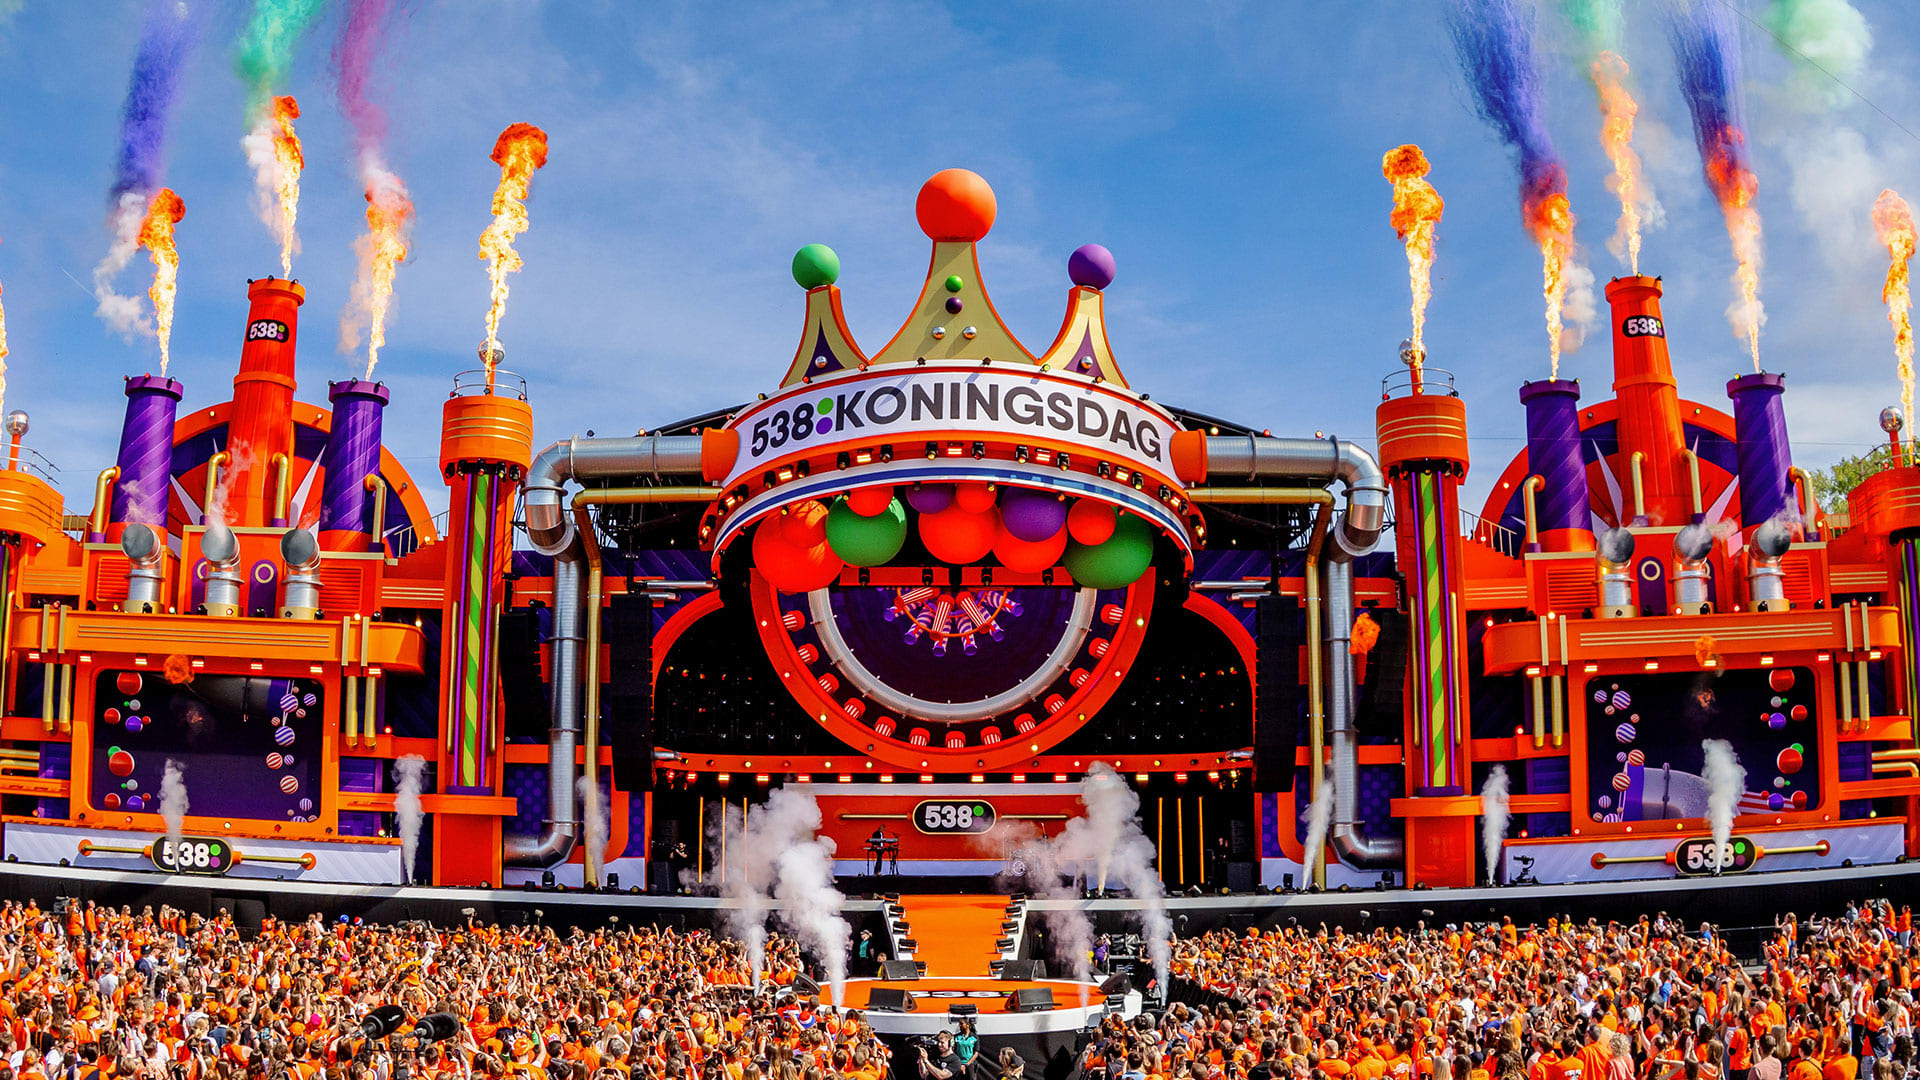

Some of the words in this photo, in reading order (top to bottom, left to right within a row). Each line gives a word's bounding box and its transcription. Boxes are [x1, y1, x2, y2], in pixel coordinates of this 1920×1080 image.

[249, 321, 278, 339] 538
[1627, 318, 1658, 335] 538
[751, 402, 815, 457] 538
[835, 382, 1162, 463] KONINGSDAG
[925, 805, 973, 829] 538
[162, 841, 210, 868] 538
[1687, 842, 1735, 869] 538
